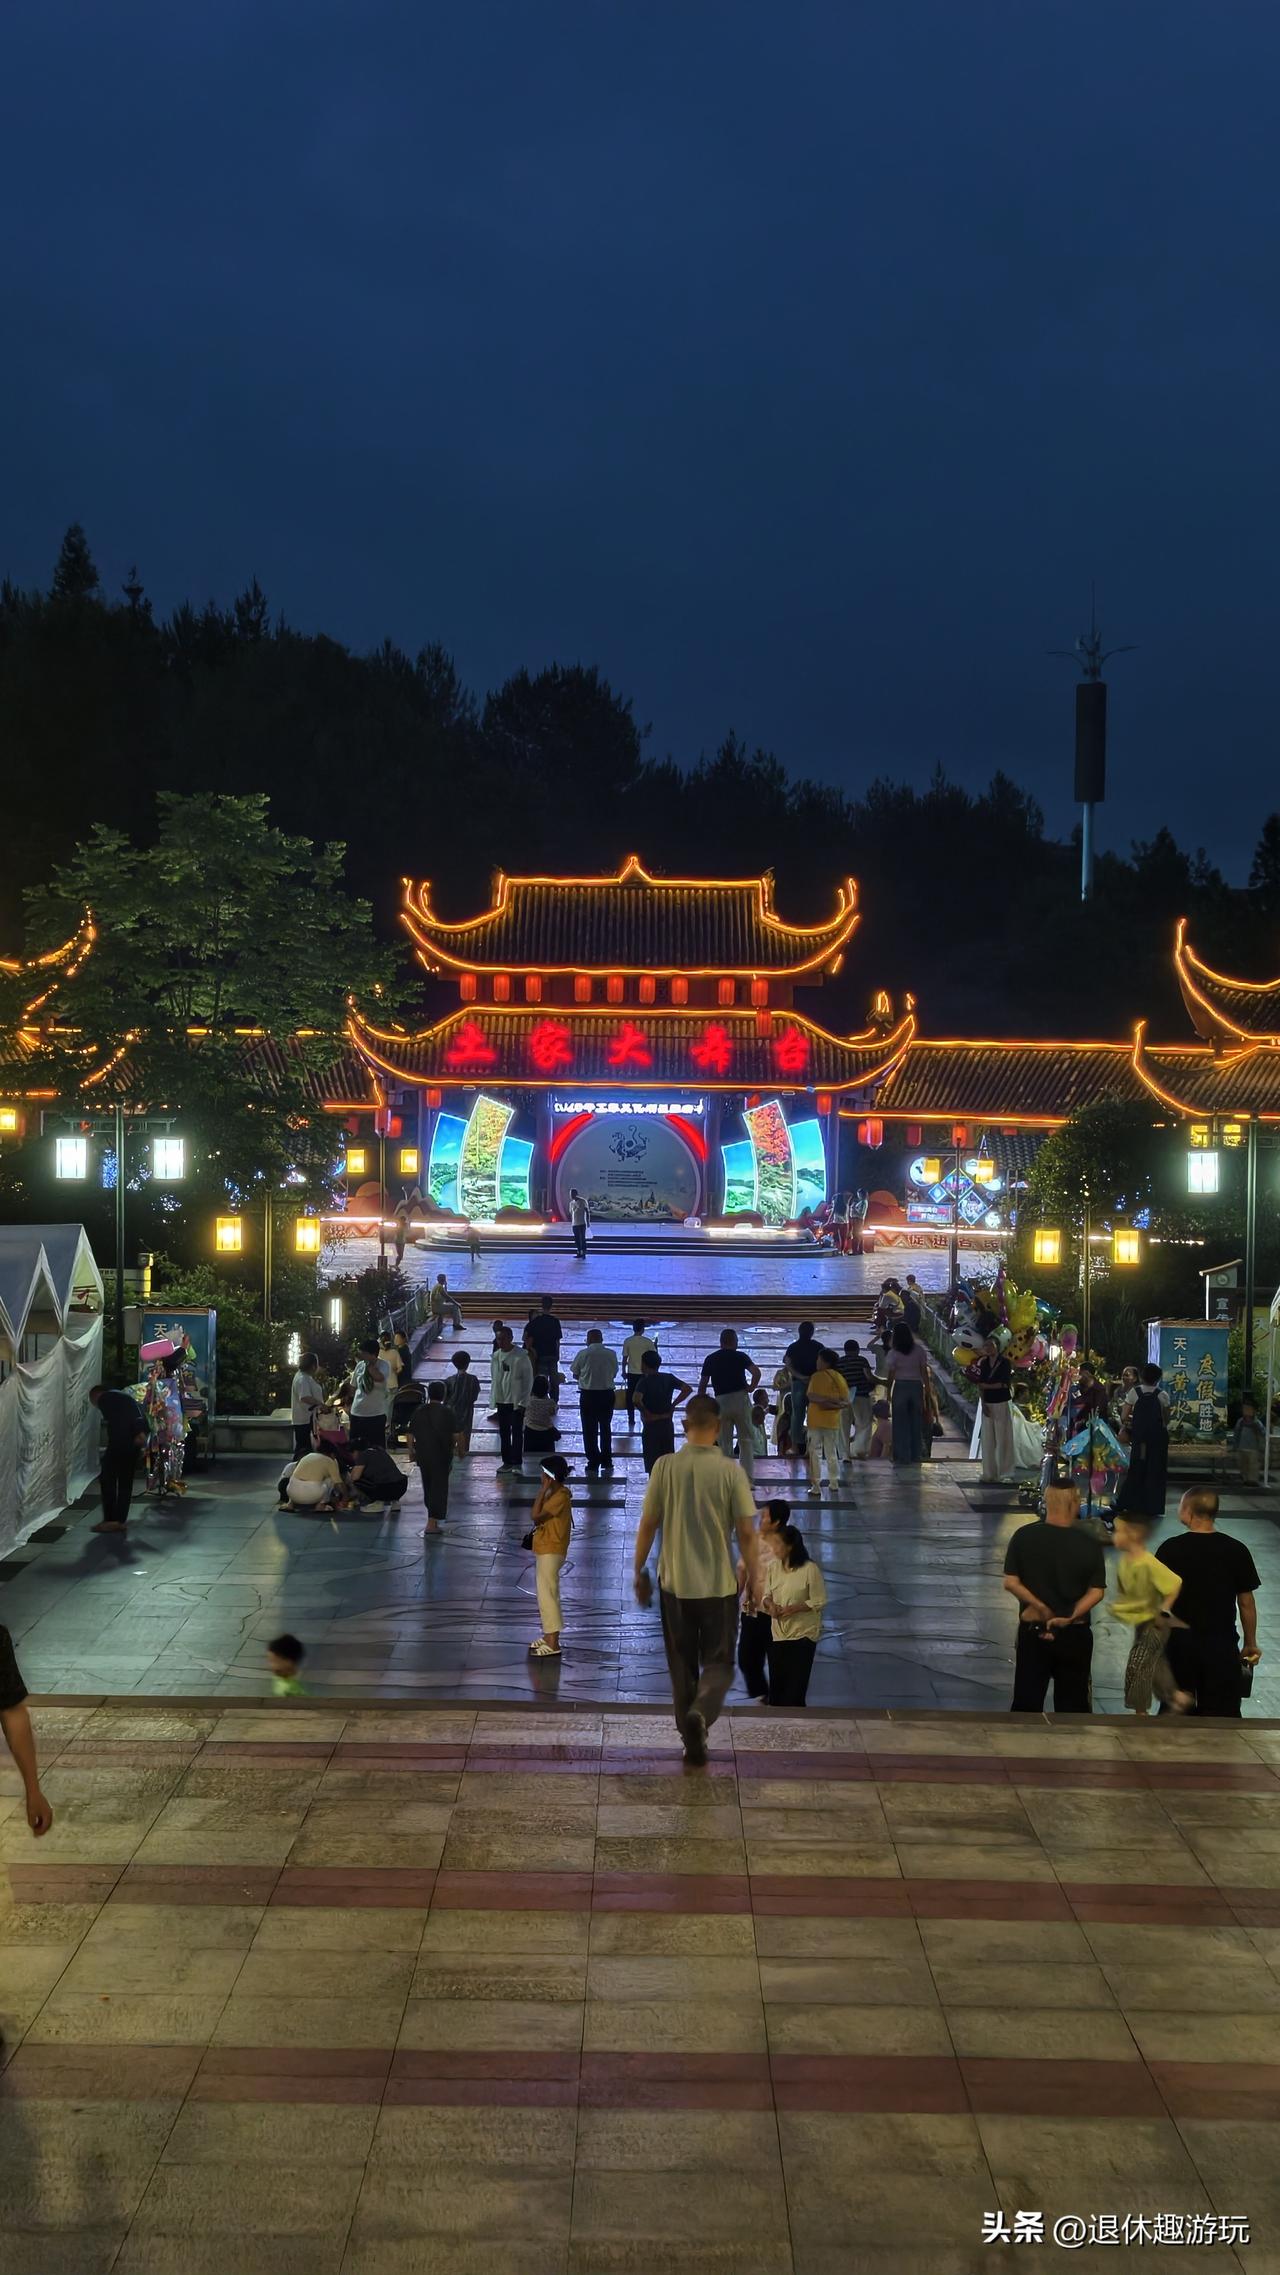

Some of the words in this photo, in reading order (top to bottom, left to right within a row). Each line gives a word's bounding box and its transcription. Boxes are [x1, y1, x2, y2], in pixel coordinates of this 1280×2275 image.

[447, 1022, 810, 1072] 土家大舞台
[1169, 1336, 1190, 1428] 天上黄水
[1196, 1353, 1217, 1431] 度假胜地
